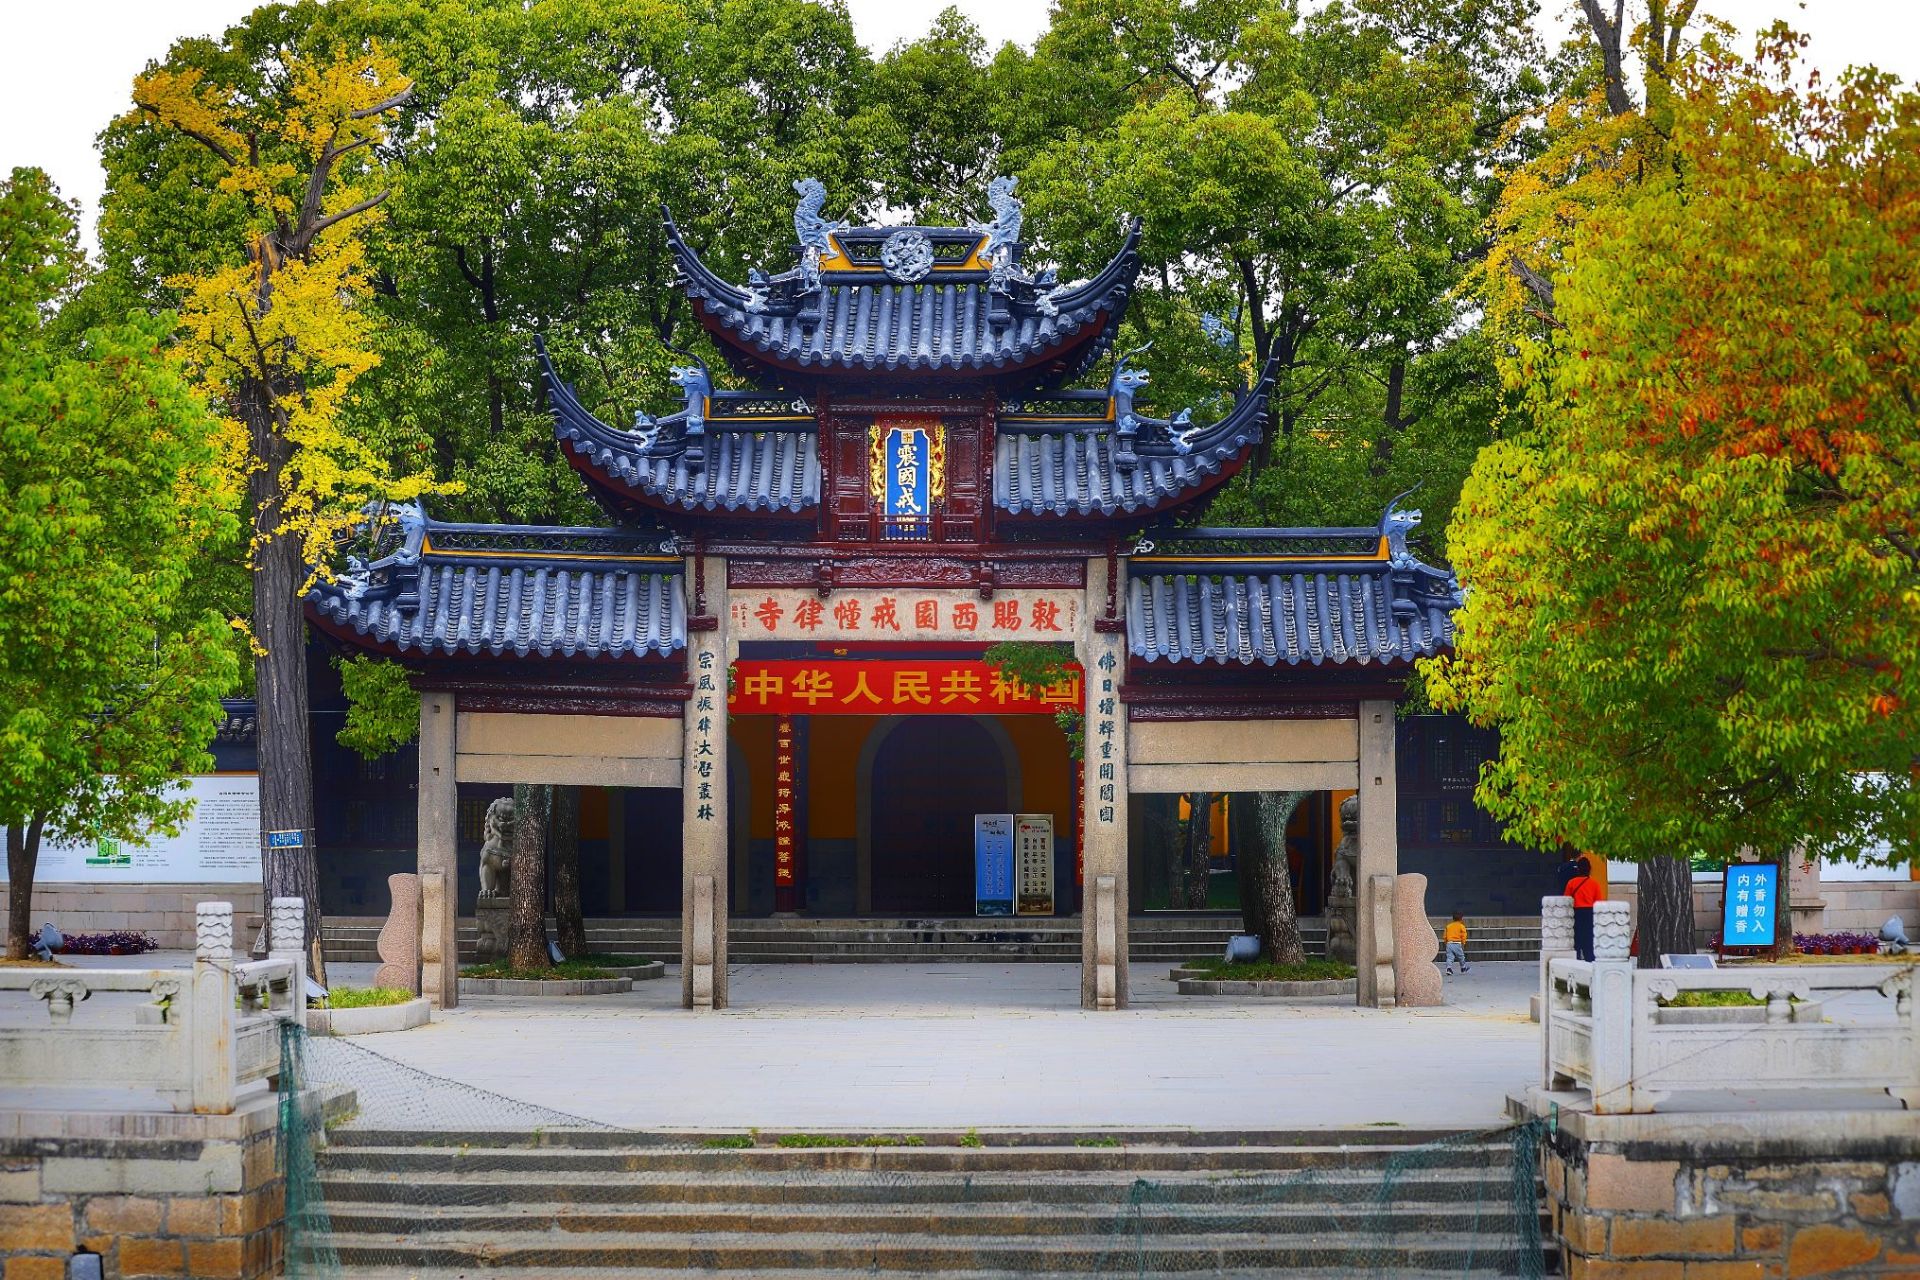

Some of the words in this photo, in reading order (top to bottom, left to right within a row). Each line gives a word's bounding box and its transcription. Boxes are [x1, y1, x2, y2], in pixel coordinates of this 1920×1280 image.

[728, 668, 1079, 705] 中华人民共和国
[1752, 873, 1767, 932] 外香勿入
